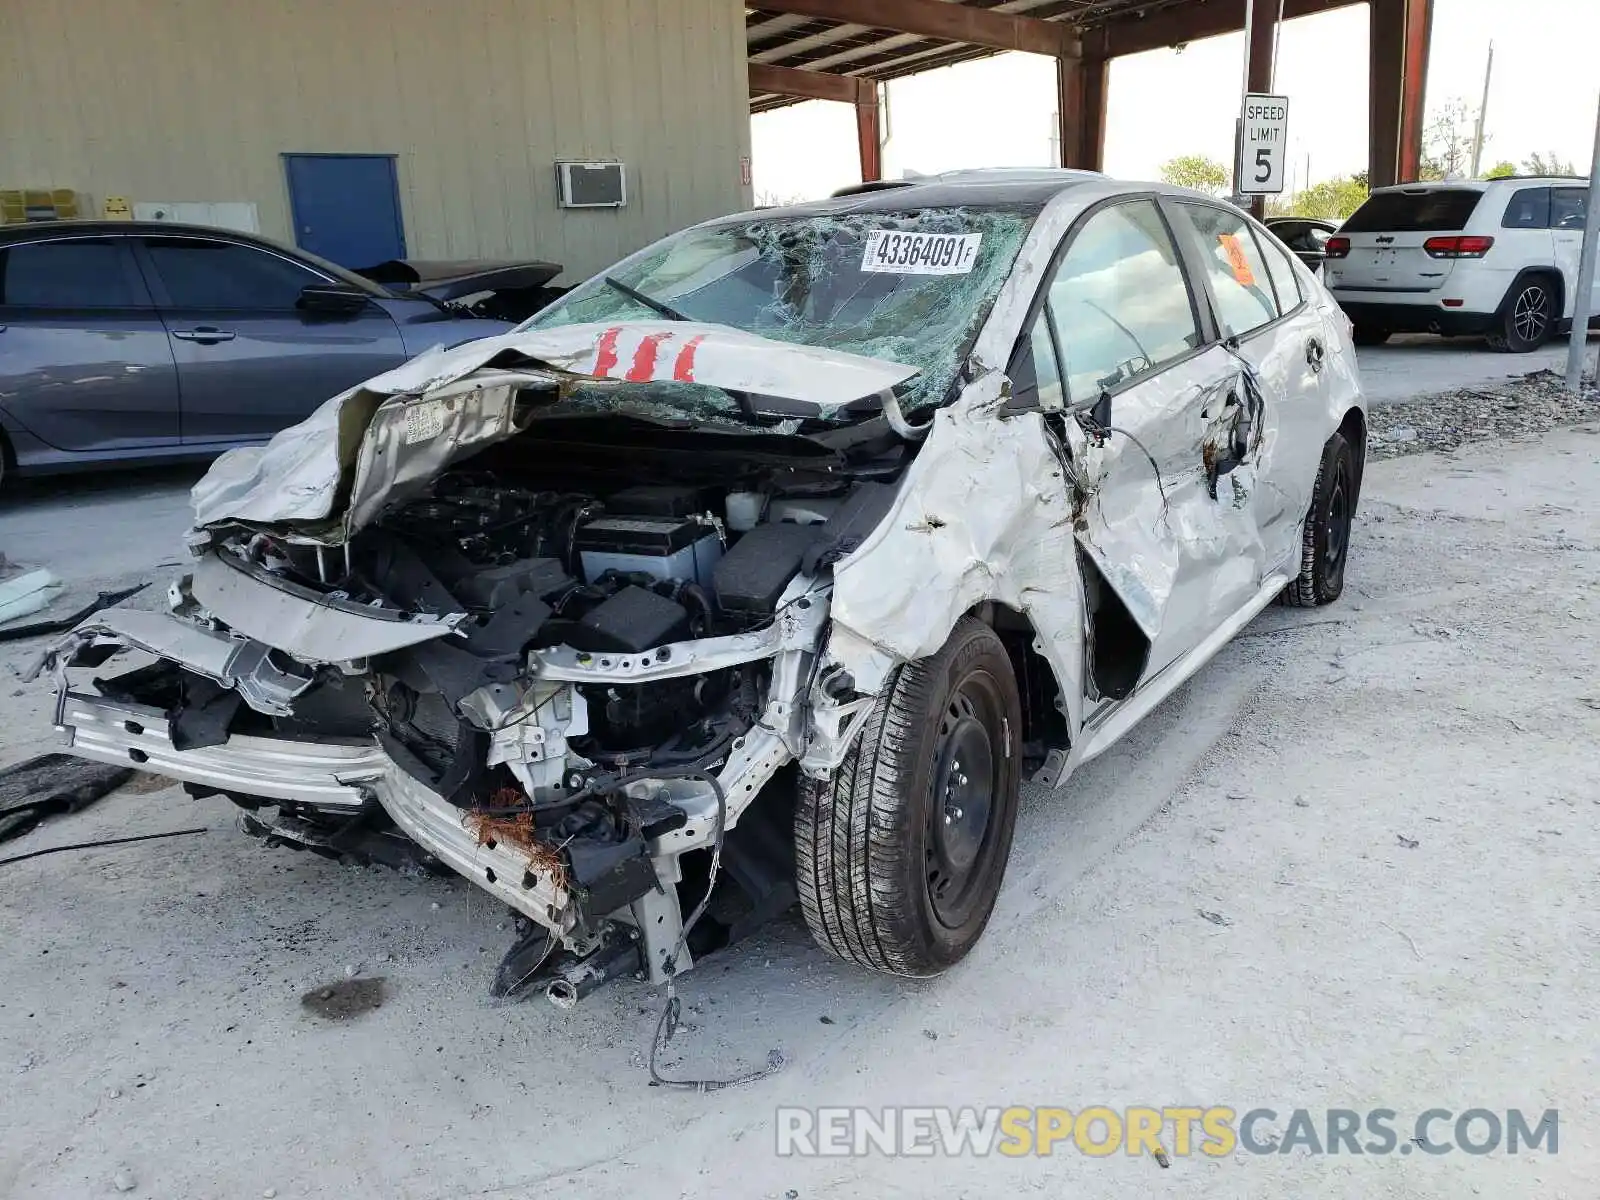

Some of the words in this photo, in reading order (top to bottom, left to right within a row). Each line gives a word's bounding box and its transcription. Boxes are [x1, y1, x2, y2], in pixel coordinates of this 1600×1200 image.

[1248, 105, 1284, 120] SPEED
[1250, 127, 1279, 142] LIMIT
[1255, 148, 1271, 183] 5
[876, 233, 966, 267] 43364091
